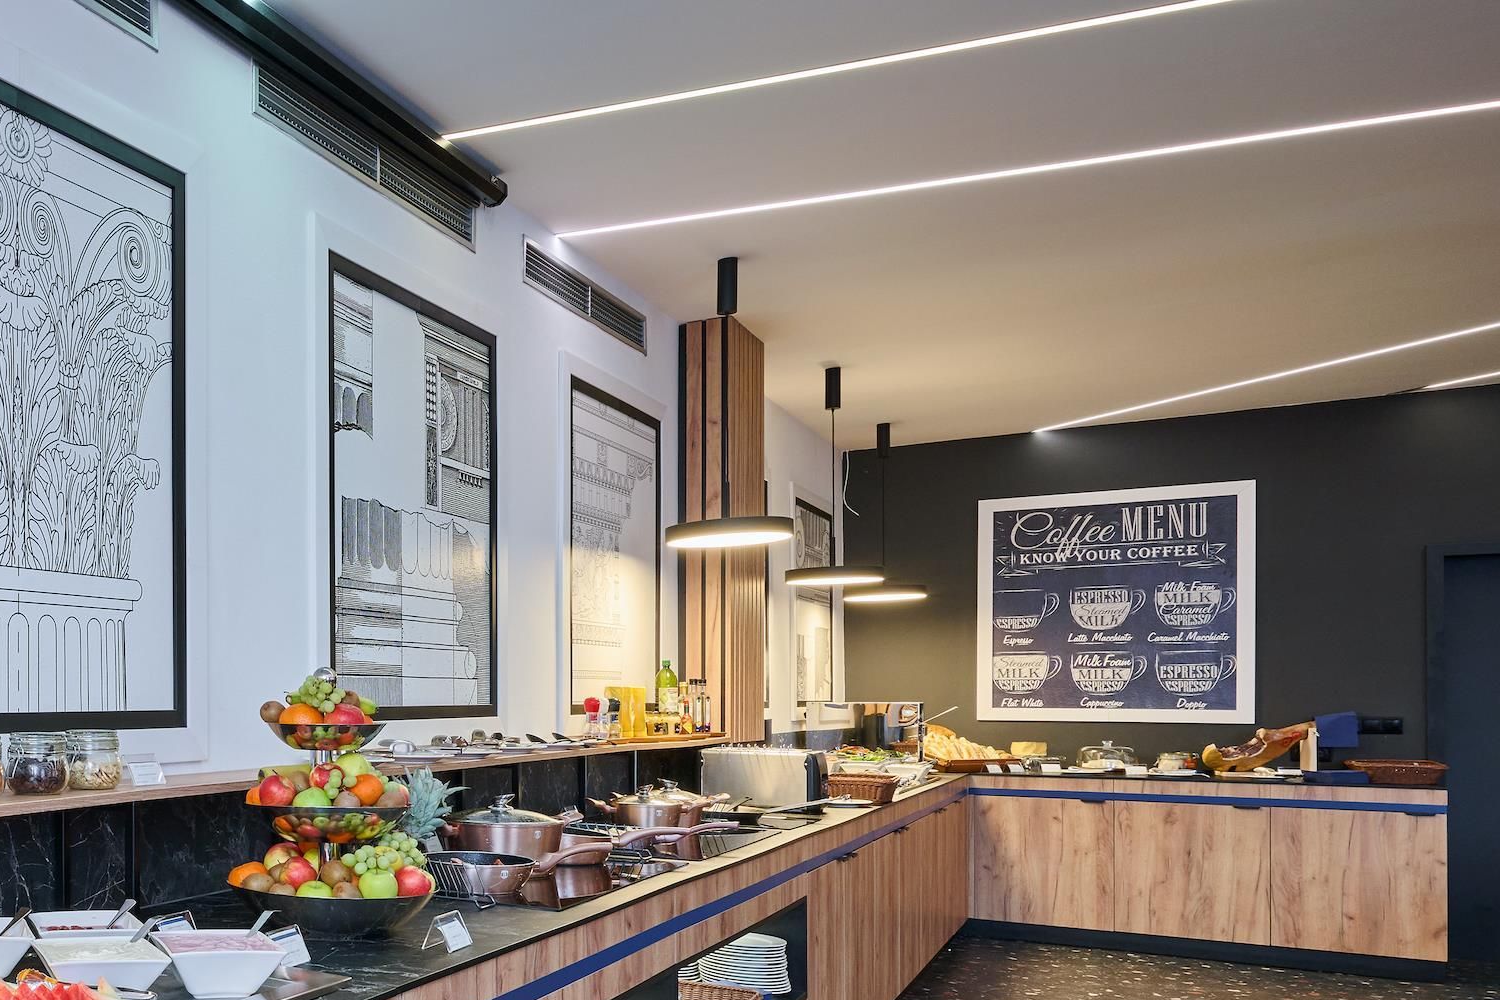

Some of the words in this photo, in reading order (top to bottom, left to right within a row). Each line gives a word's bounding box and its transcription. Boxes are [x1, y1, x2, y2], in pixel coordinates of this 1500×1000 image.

[1011, 511, 1116, 558] Coffee
[1121, 502, 1208, 541] MENU
[1020, 551, 1068, 565] KNOW
[1075, 548, 1122, 563] YOUR
[1127, 544, 1199, 560] COFFEE
[1162, 581, 1187, 592] Milk
[1190, 581, 1216, 592] Foam
[1074, 589, 1128, 604] ESPRESSO
[1164, 592, 1211, 603] MILK
[1075, 604, 1128, 616] Steamed
[1160, 603, 1215, 616] Caramel
[996, 617, 1038, 630] ESPRESSO
[1078, 615, 1121, 627] MILK
[1164, 614, 1212, 626] ESPRESSO
[1003, 634, 1034, 646] Espresso
[1067, 633, 1088, 643] Latte
[1091, 632, 1133, 642] Macchiato
[1147, 632, 1184, 642] Caramel
[1186, 631, 1230, 642] Macchiato
[1074, 654, 1103, 667] Milk
[1102, 654, 1132, 667] Foam
[997, 668, 1040, 679] MILK
[1079, 669, 1123, 680] MILK
[1160, 665, 1218, 679] ESPRESSO
[998, 680, 1041, 691] ESPRESSO
[1080, 681, 1124, 692] ESPRESSO
[1165, 681, 1213, 692] ESPRESSO
[1001, 698, 1019, 708] Flat
[1021, 698, 1045, 708] White
[1080, 697, 1124, 709] Cappuccino
[1177, 698, 1208, 709] Doppio
